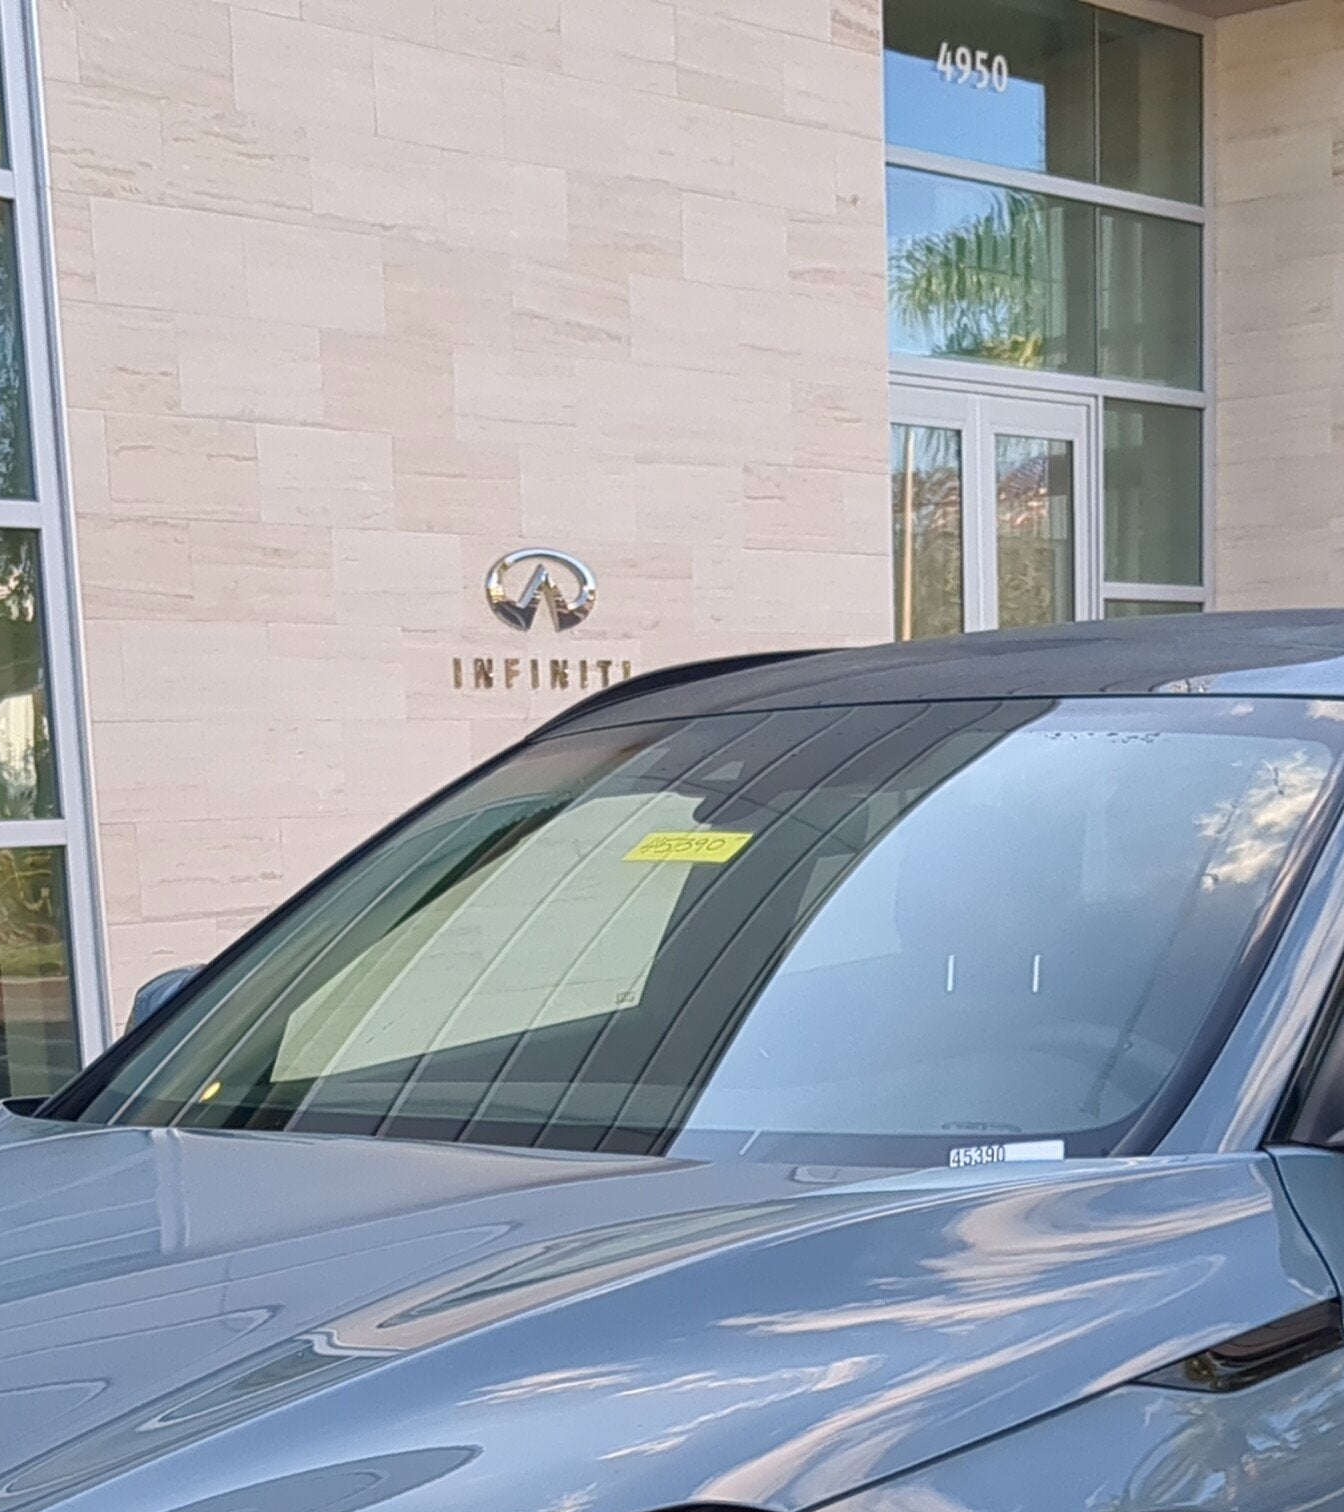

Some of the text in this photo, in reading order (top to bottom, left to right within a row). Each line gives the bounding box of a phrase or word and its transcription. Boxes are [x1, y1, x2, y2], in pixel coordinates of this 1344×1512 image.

[937, 41, 1008, 92] 4950
[453, 658, 632, 689] INFINITI
[951, 1145, 1005, 1167] 45390
